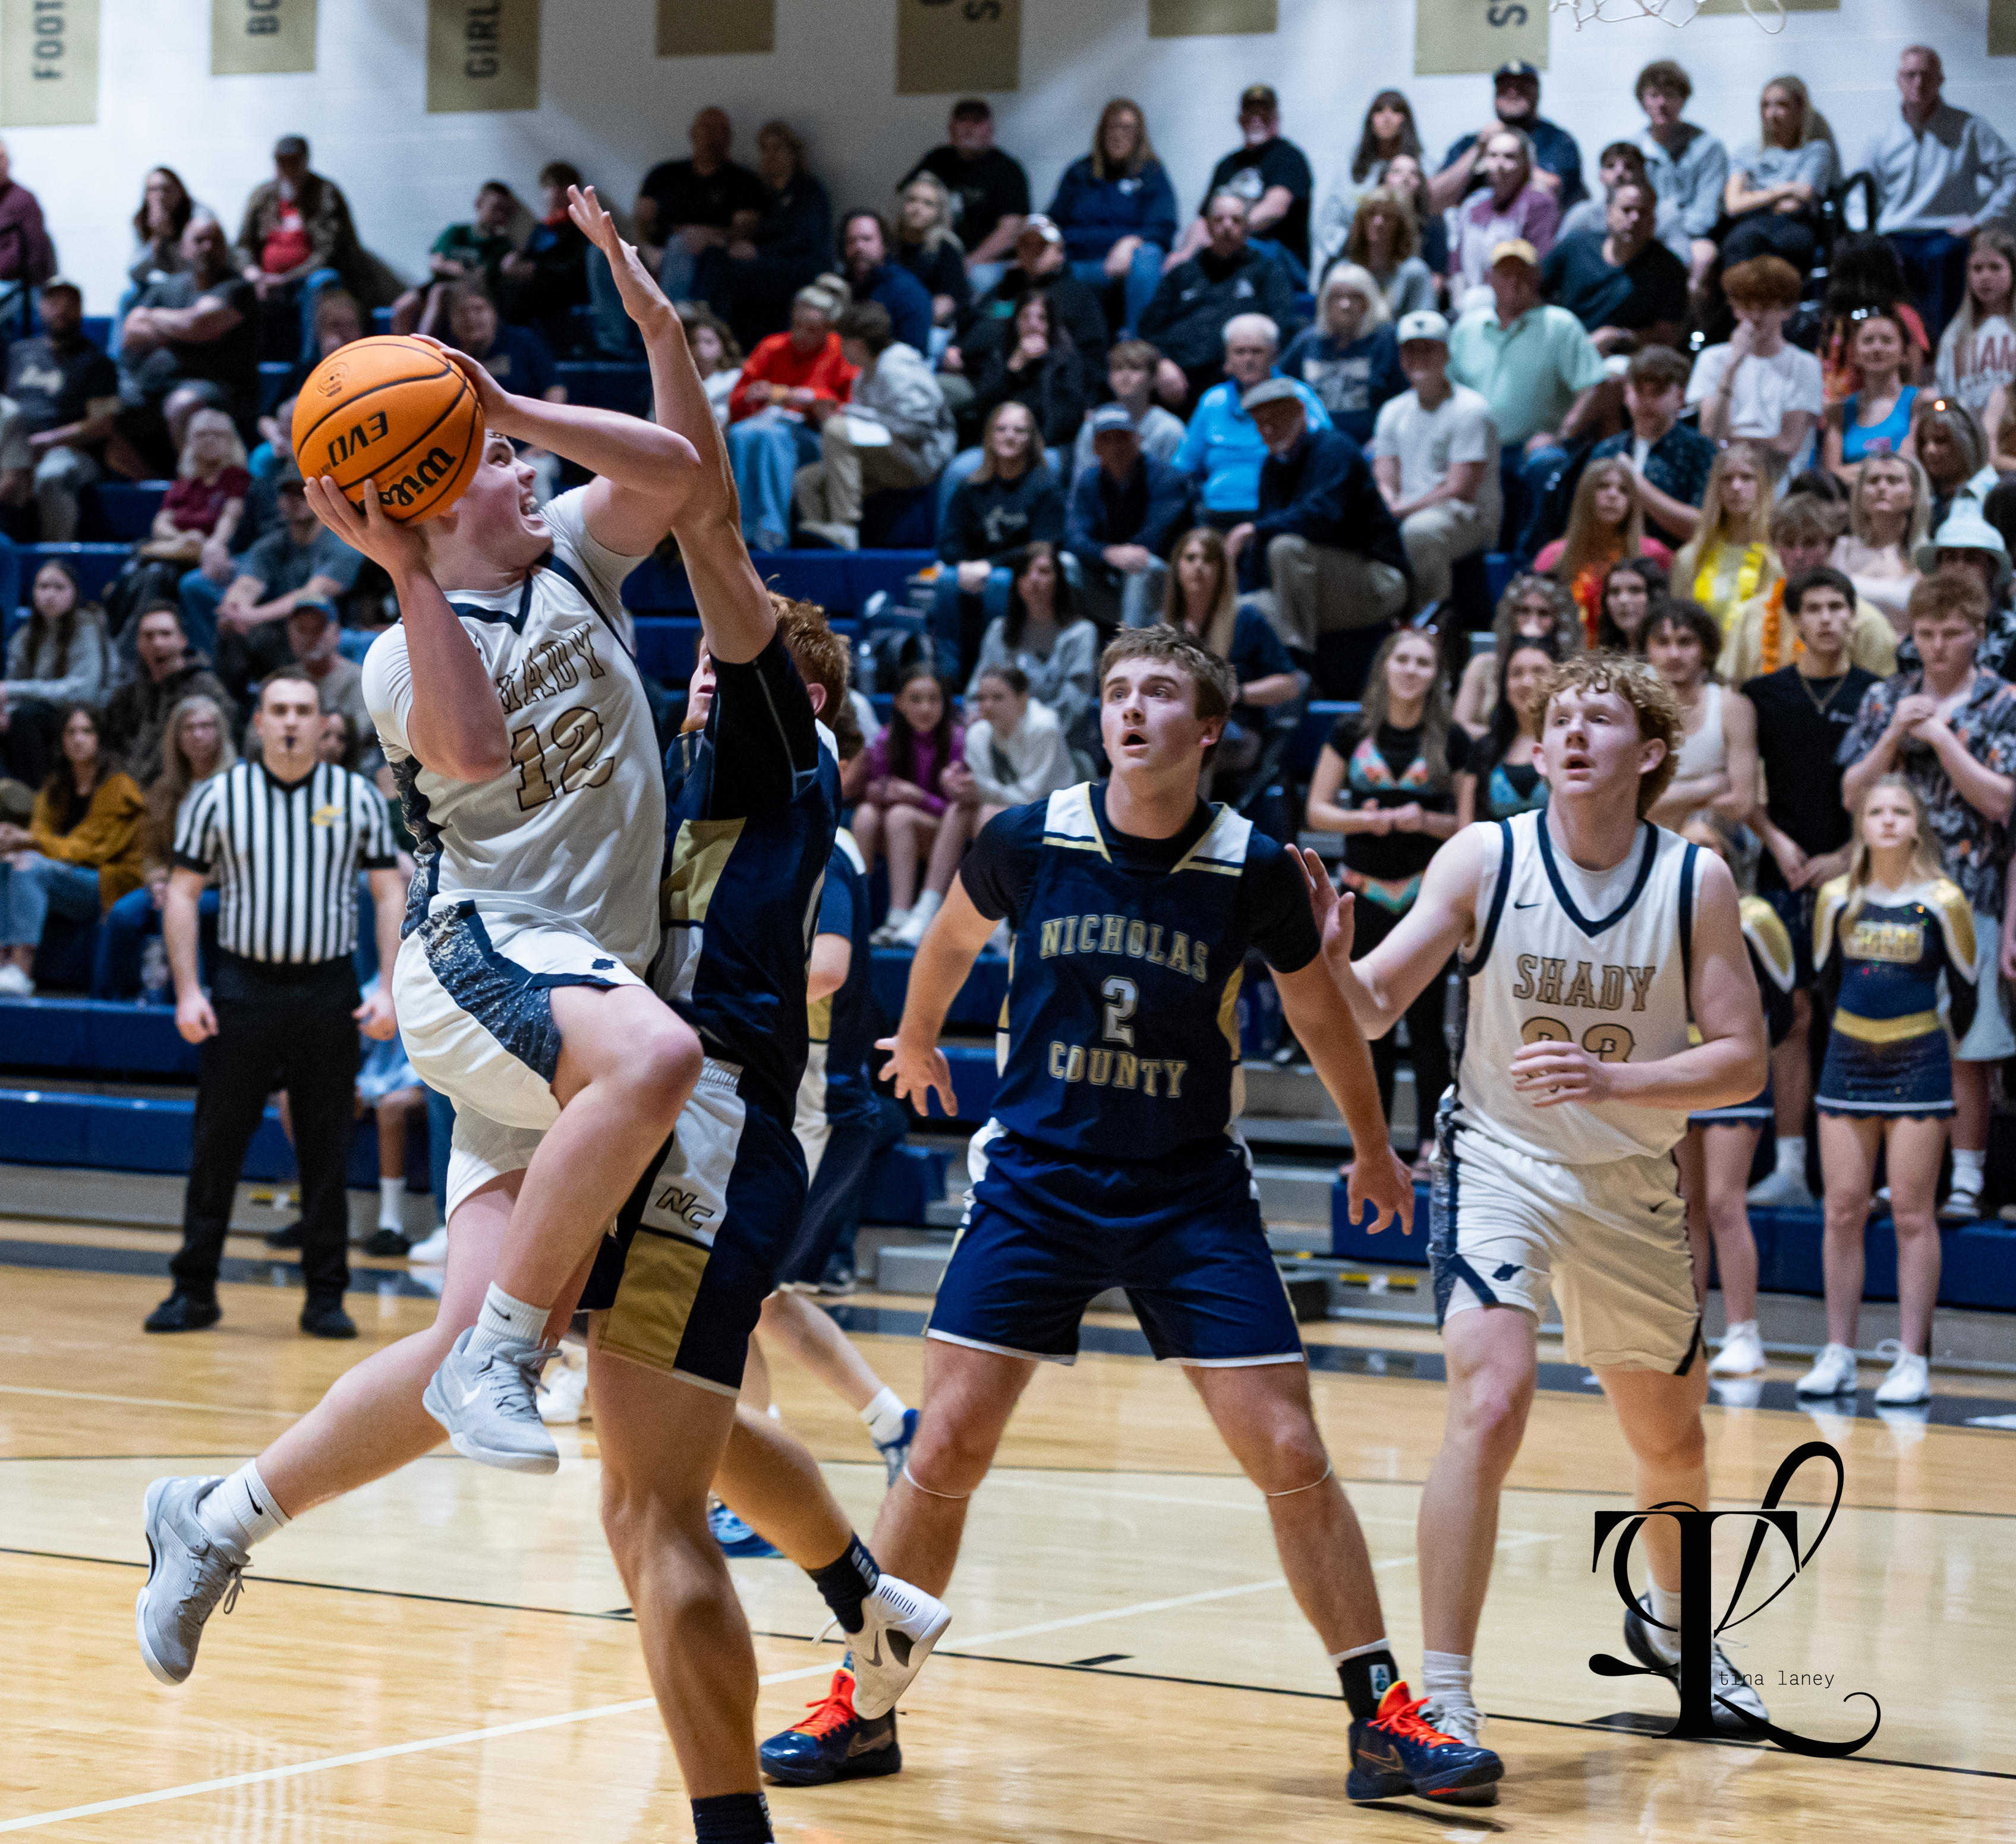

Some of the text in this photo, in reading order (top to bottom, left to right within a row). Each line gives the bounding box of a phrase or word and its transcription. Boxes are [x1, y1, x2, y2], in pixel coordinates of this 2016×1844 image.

[1487, 0, 1527, 27] S
[327, 410, 388, 468] EVO
[496, 623, 606, 715] HADY
[511, 706, 615, 812] 12
[1040, 914, 1209, 983] NICHOLAS
[1513, 953, 1656, 1011] SHADY
[1101, 975, 1139, 1048] 2
[1048, 1041, 1187, 1098] COUNTY
[655, 1186, 716, 1230] NC
